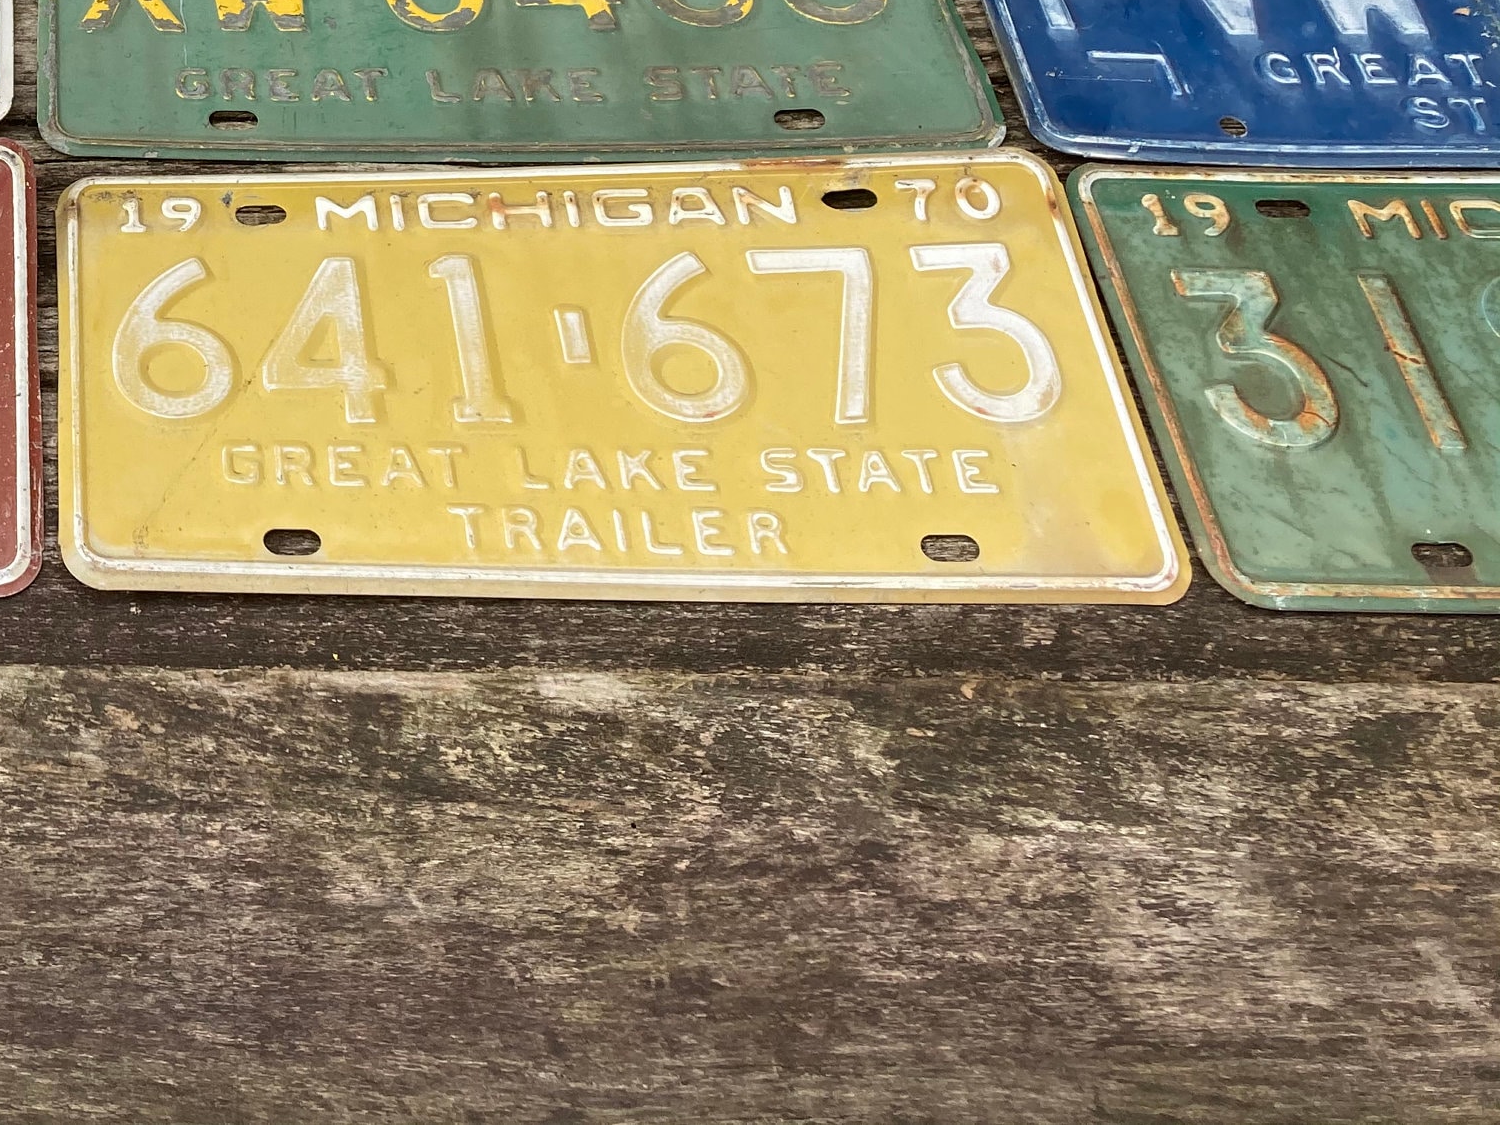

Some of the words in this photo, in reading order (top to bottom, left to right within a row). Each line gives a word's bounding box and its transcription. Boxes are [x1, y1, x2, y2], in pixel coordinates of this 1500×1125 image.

[174, 68, 388, 103] GREAT
[426, 68, 606, 104] LAKE
[646, 63, 852, 102] STATE
[1258, 50, 1484, 87] GREAT
[119, 196, 204, 235] 19
[313, 185, 798, 231] MICHIGAN
[894, 178, 1002, 222] 70
[1141, 193, 1231, 237] 19
[221, 443, 465, 490] GREAT
[522, 446, 716, 492] LAKE
[764, 448, 1002, 495] STATE
[446, 504, 791, 558] TRAILER
